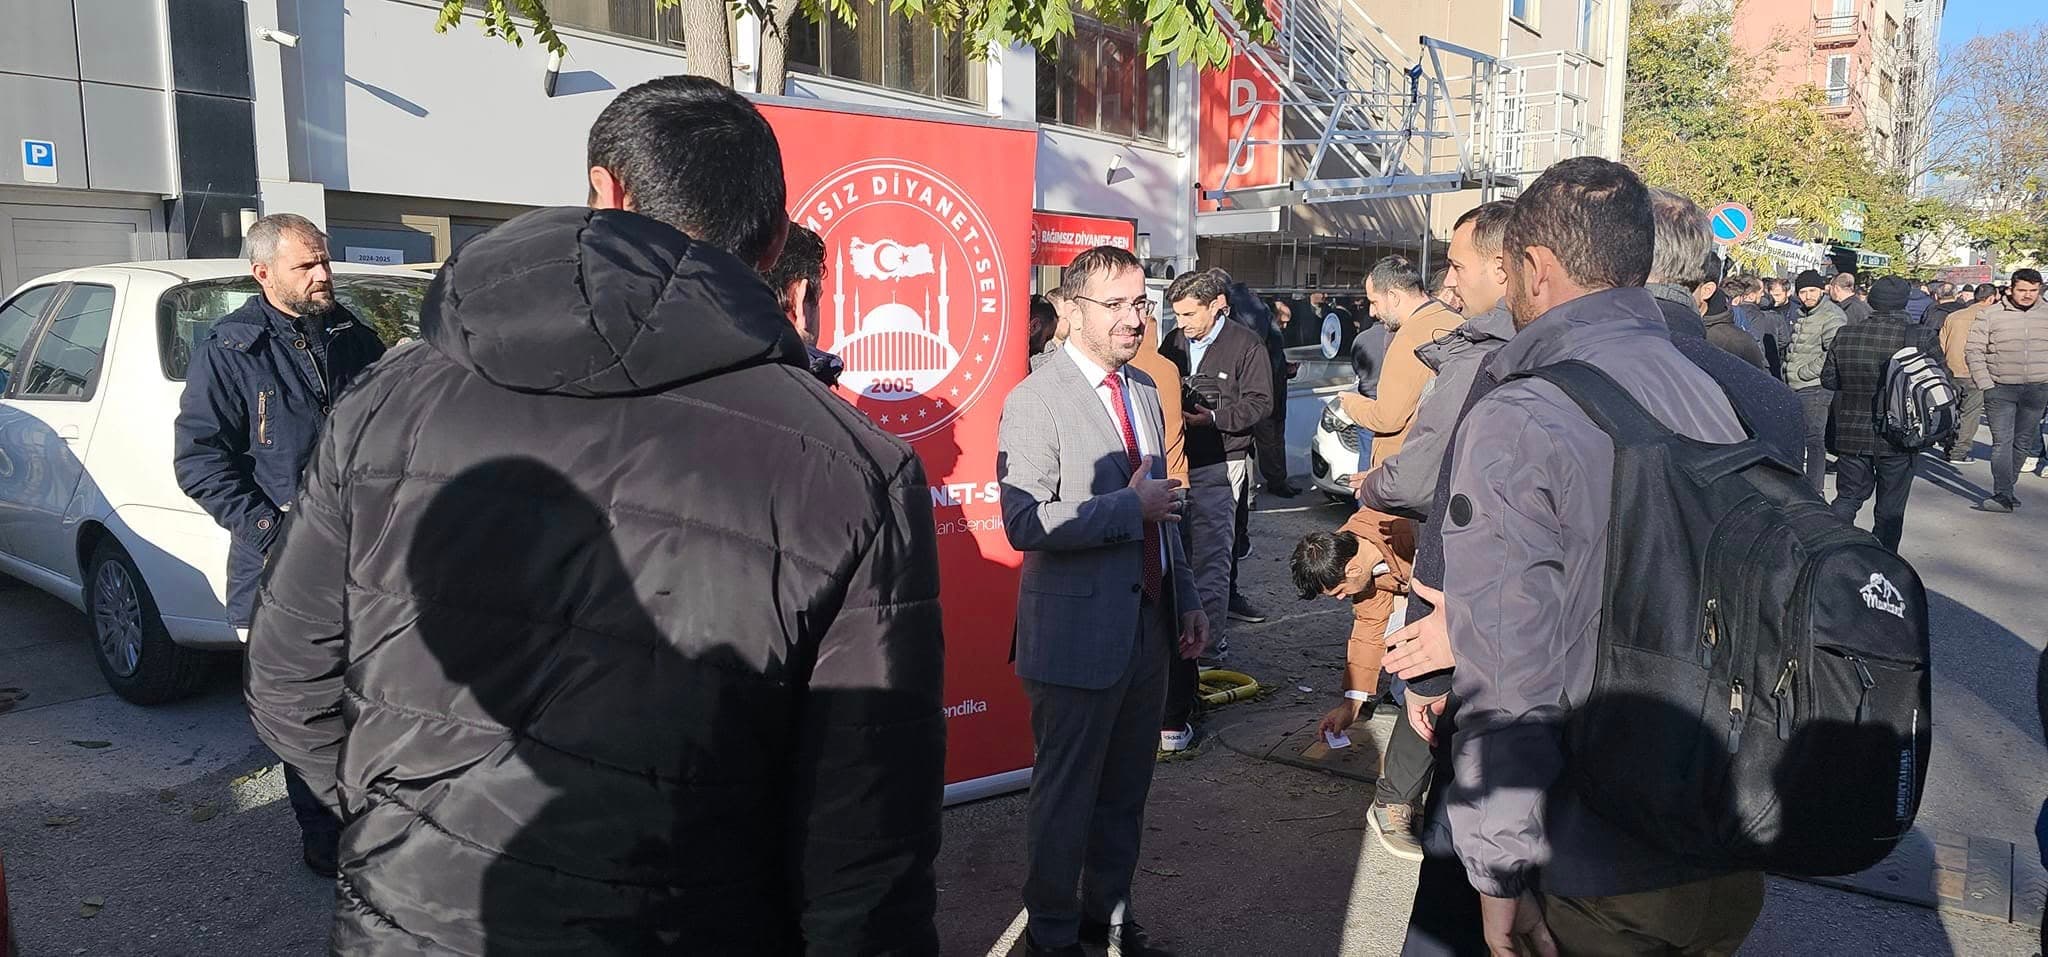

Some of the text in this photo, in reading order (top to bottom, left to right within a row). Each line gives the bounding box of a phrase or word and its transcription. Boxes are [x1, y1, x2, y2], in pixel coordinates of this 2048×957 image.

[31, 144, 48, 164] P
[803, 173, 997, 313] MSIZ DİYANET-SEN
[1041, 228, 1129, 249] BAĞIMSIZ DİYANET-SEN
[359, 254, 391, 263] 2024-2025
[870, 377, 914, 394] 2005
[930, 482, 1001, 507] NET-S
[935, 513, 1005, 535] lan Sendik
[943, 699, 988, 718] endika
